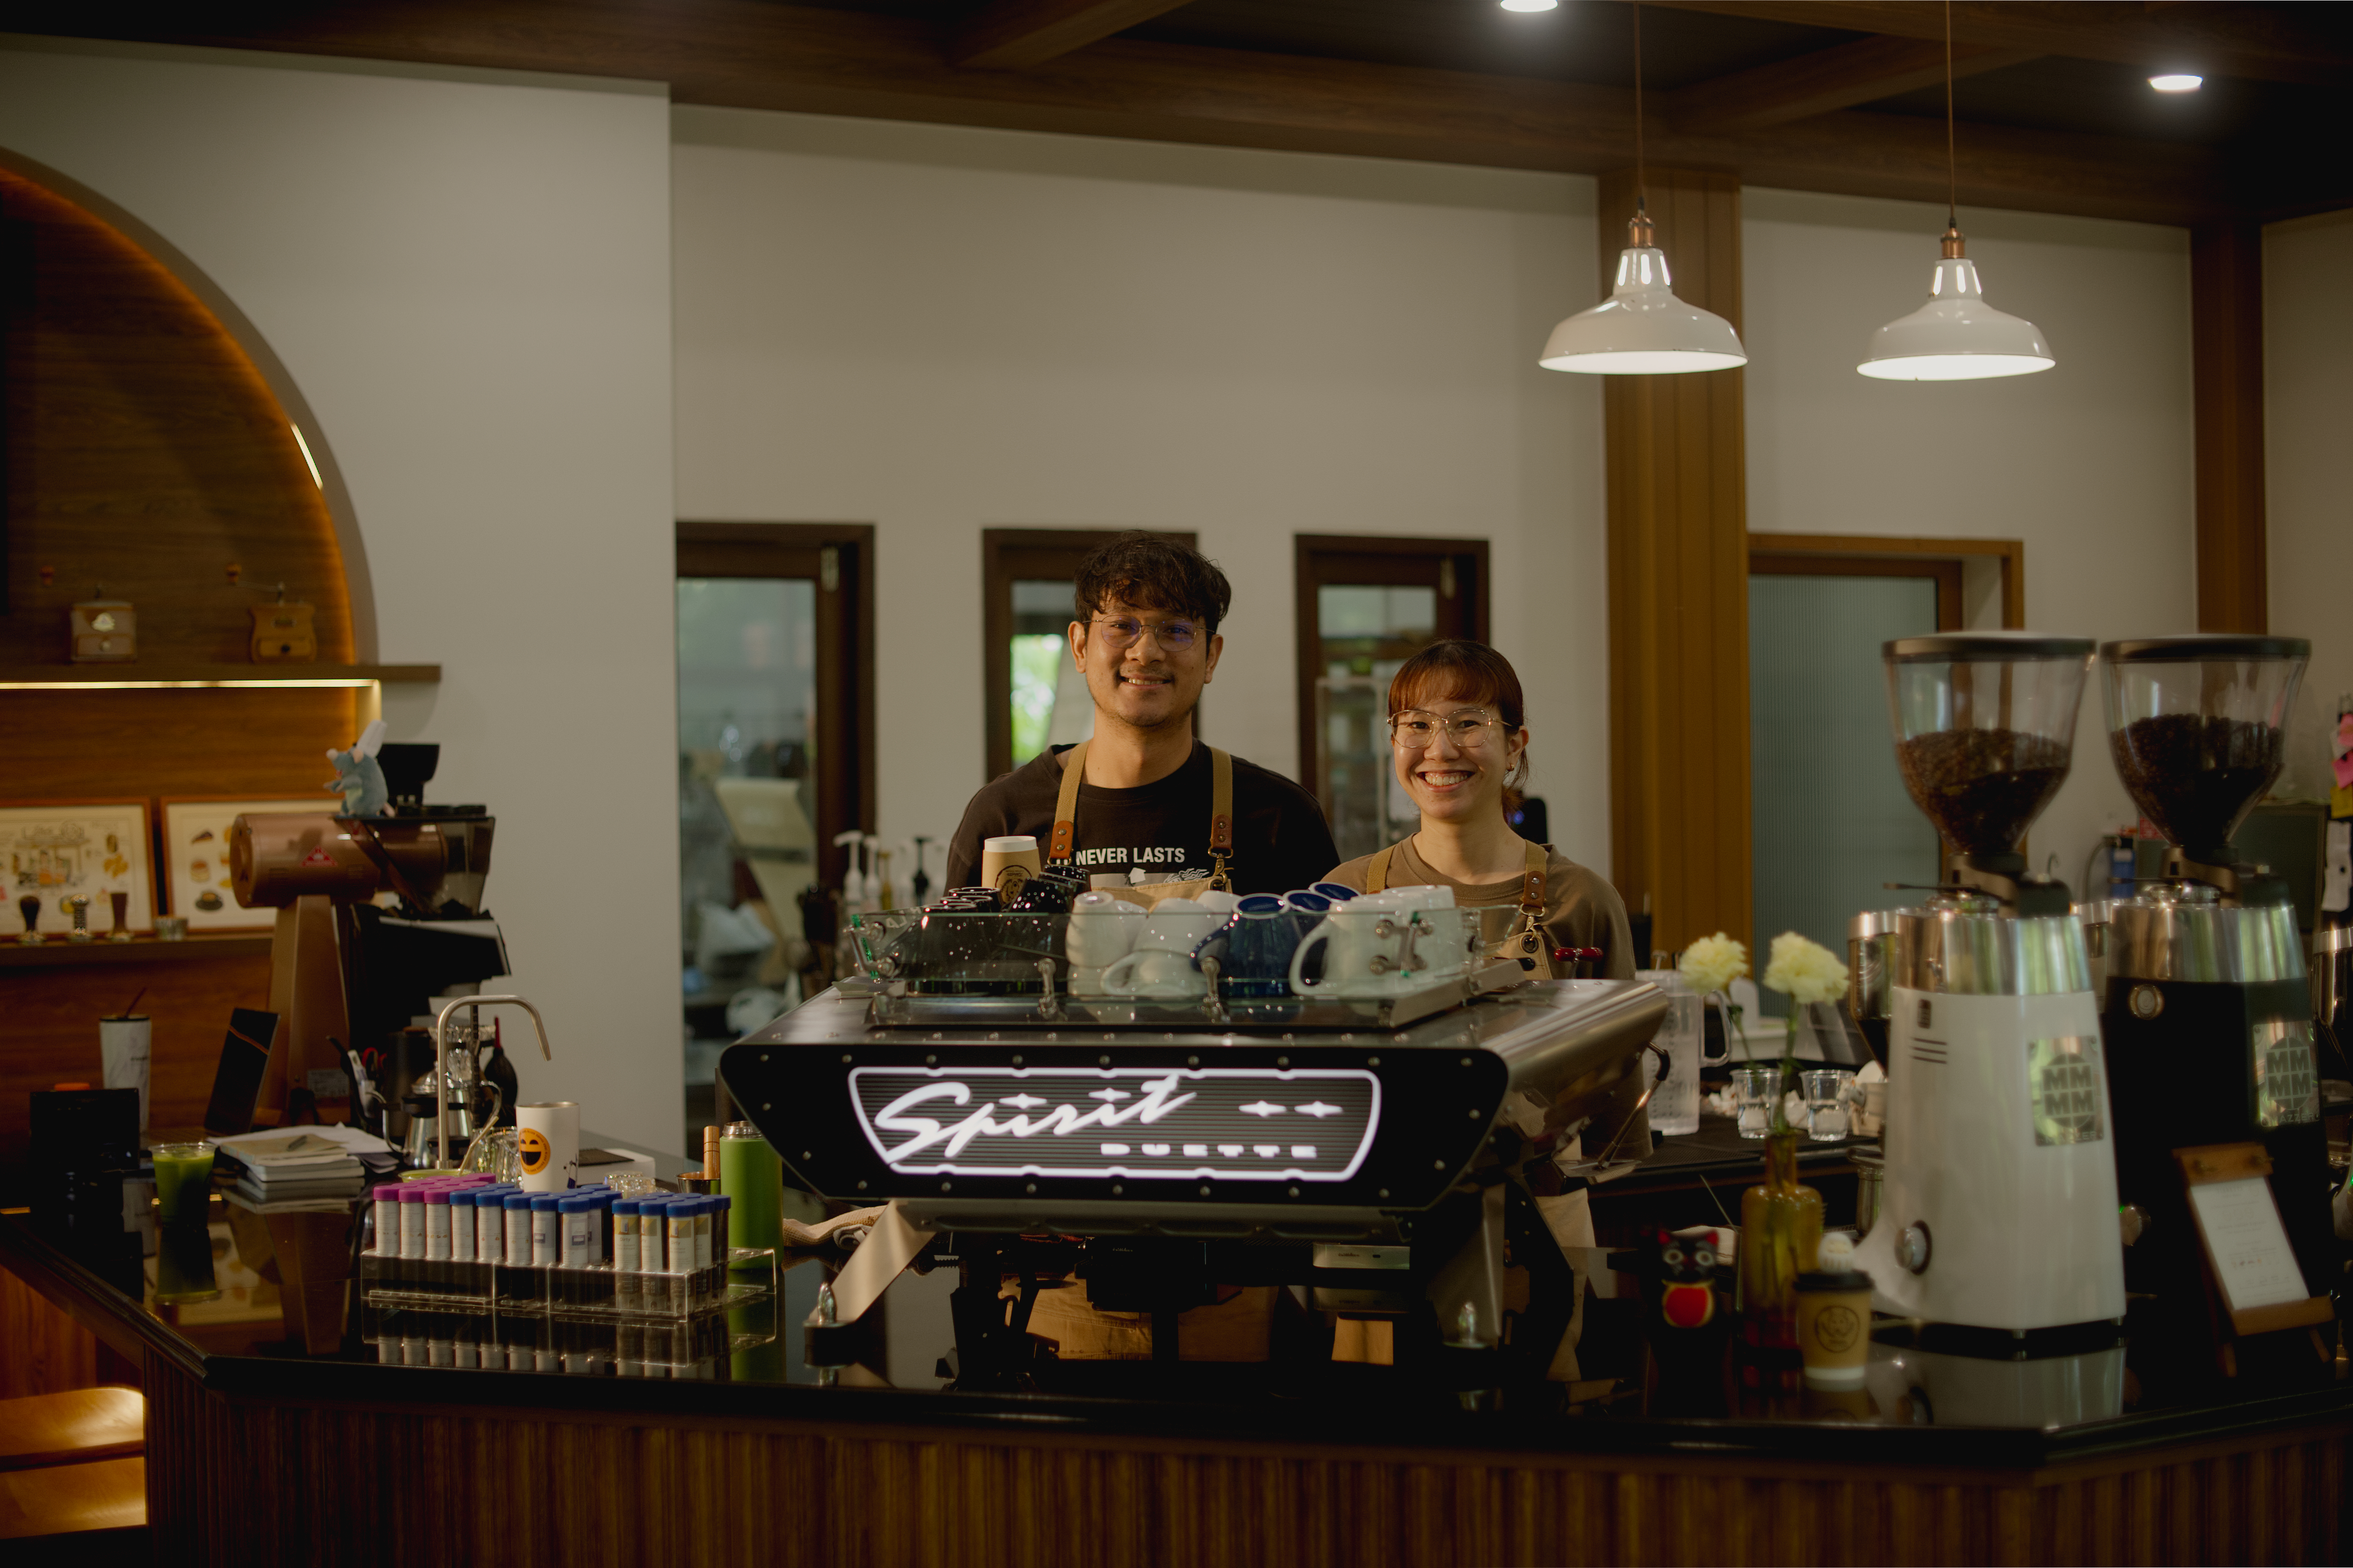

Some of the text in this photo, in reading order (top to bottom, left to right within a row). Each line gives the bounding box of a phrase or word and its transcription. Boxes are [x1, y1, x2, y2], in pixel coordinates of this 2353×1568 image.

[1076, 848, 1127, 865] NEVER
[1133, 847, 1185, 863] LASTS
[875, 1074, 1197, 1163] Spirit
[1101, 1144, 1316, 1158] DUETTE
